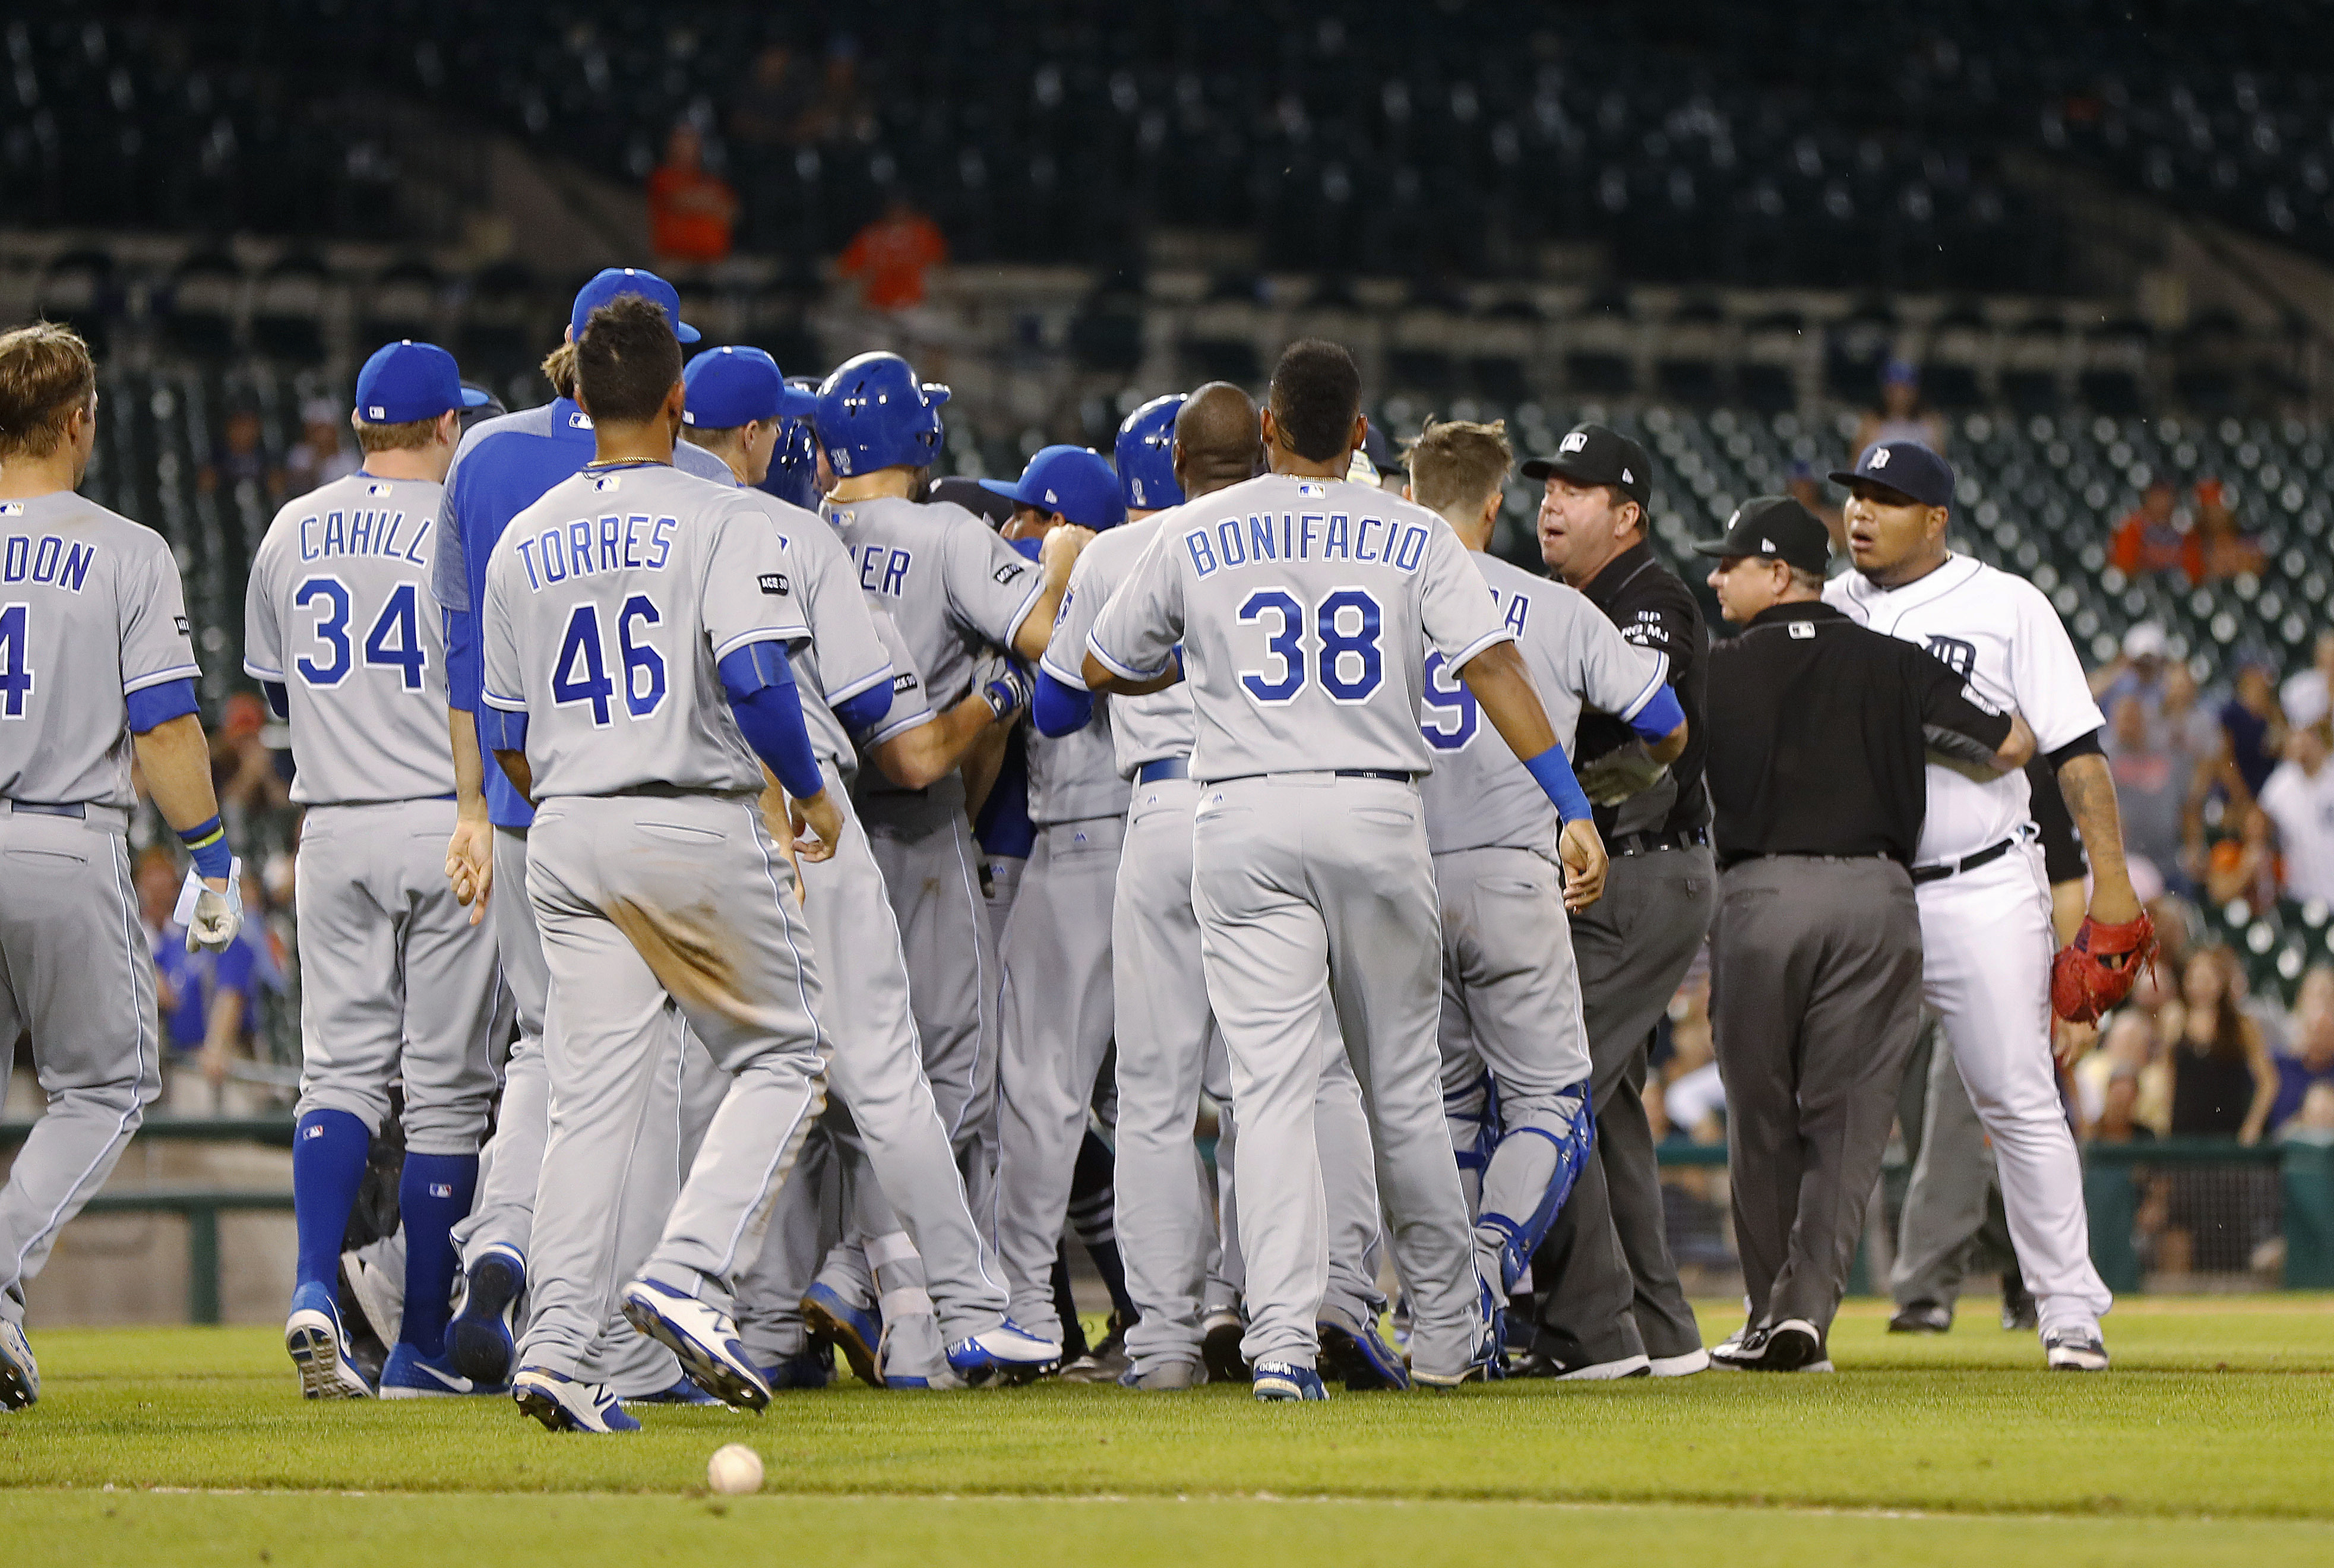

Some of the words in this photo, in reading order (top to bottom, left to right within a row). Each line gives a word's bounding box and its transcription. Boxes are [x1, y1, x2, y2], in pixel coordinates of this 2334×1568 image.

[298, 507, 434, 568] CAHILL
[514, 512, 679, 595] TORRES
[1182, 510, 1433, 581] BONIFACIO
[761, 577, 779, 589] ACE
[1489, 586, 1532, 642] A
[293, 573, 429, 694] 34
[549, 591, 670, 731] 46
[1235, 584, 1385, 707] 38
[1421, 646, 1481, 755] 9
